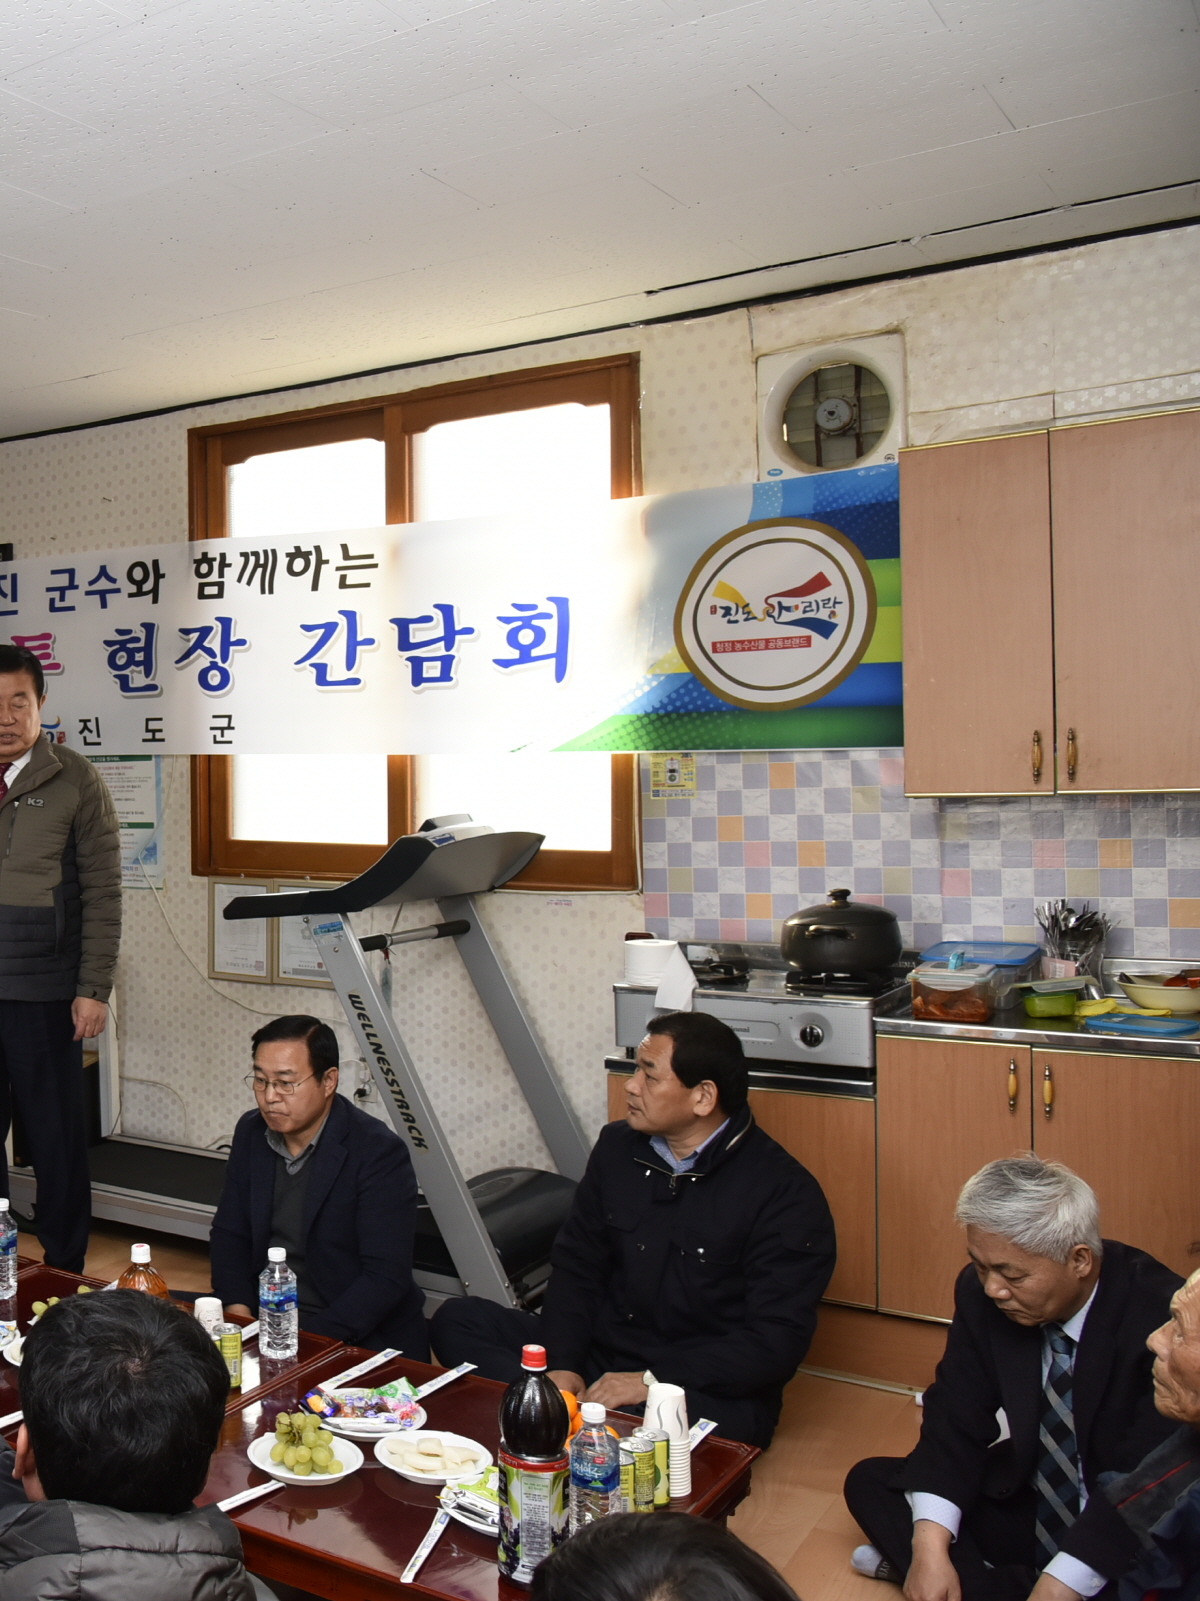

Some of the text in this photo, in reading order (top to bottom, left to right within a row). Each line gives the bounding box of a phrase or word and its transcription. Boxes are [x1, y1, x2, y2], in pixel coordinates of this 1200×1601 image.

[45, 558, 166, 613] 군수와
[192, 542, 379, 601] 함께하는
[101, 615, 249, 694] 현장
[293, 595, 571, 689] 간담회
[715, 637, 809, 653] 청정 농수산물 공동브랜드
[347, 993, 429, 1151] WELLNESSTRACK
